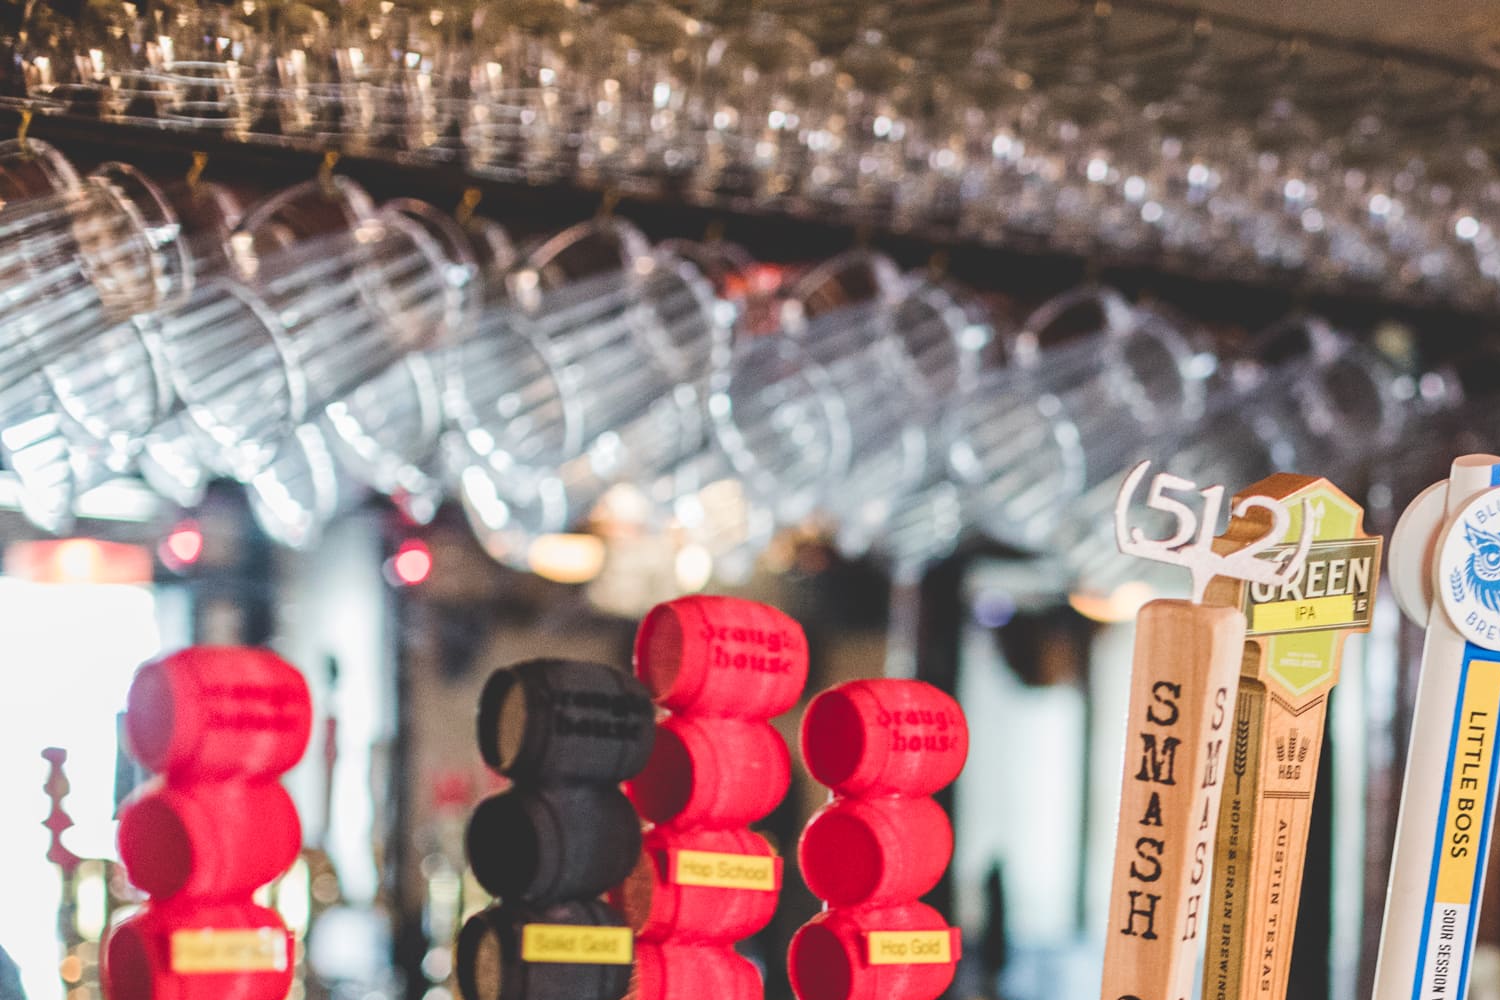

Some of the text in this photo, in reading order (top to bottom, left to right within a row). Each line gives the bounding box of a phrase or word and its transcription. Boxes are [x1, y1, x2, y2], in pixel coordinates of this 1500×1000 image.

[1115, 459, 1315, 584] (512)
[1295, 606, 1317, 622] IPA
[1120, 681, 1182, 940] SMASH
[1450, 709, 1488, 859] LITTLE BOSS
[717, 863, 769, 883] School
[1221, 864, 1237, 920] GRAIN
[1261, 819, 1288, 992] AUSTIN TEXAS
[1441, 907, 1457, 940] SOUR
[1433, 942, 1452, 995] SESSION
